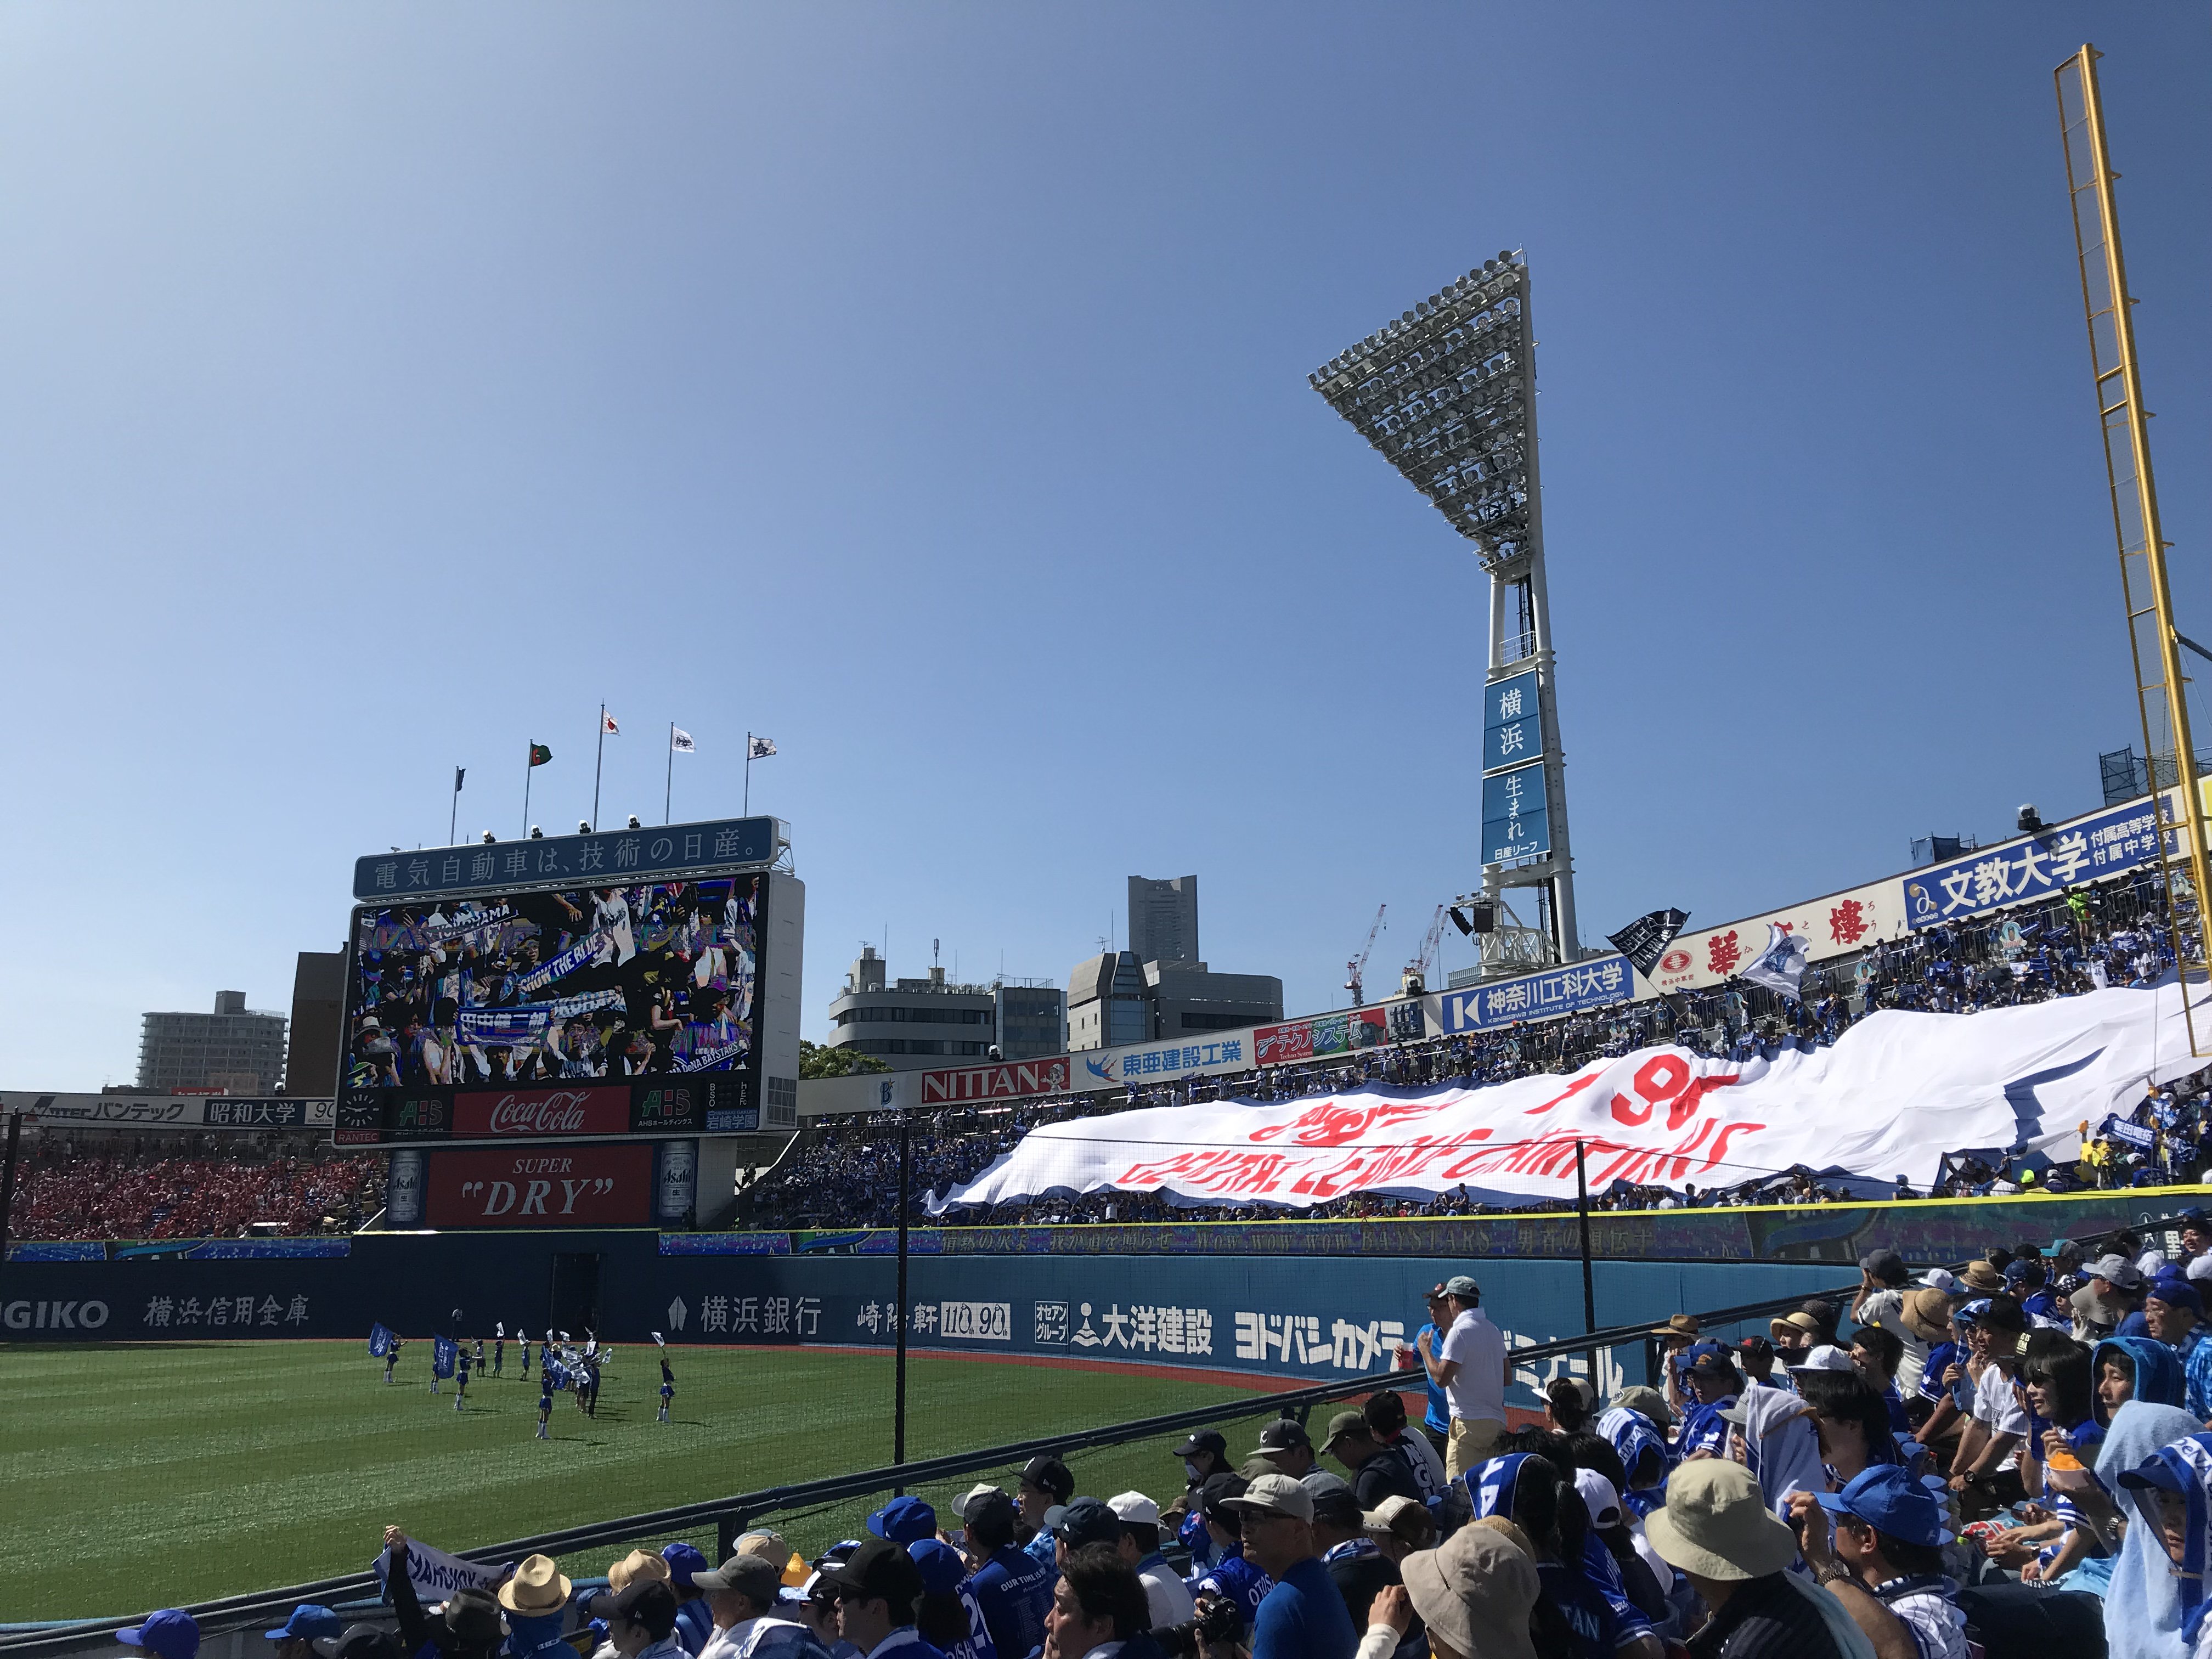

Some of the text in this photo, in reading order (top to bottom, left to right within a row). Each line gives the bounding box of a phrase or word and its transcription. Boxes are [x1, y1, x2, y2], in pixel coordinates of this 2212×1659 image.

[1499, 688, 1525, 841] 横浜 生まれ
[374, 828, 754, 890] 電気自動車は、技術の日産。
[1494, 841, 1538, 860] 日産リーフ
[1940, 831, 2090, 916] 文教大学
[521, 932, 600, 992] SHOW THE BLUE
[1487, 961, 1624, 1016] 神奈川工科大学
[1528, 1005, 1564, 1018] INSTITUTE
[1565, 1002, 1576, 1011] OF
[1577, 990, 1626, 1008] TECHNOLOGY
[1277, 1023, 1363, 1053] テクノシステム
[701, 1042, 738, 1065] BAYSTARS
[1122, 1039, 1242, 1078] 東亜建設工業
[1279, 1050, 1313, 1061] Techno System
[709, 1081, 747, 1091] B H
[925, 1064, 1041, 1100] NITTAN
[95, 1102, 184, 1120] バンテック
[210, 1102, 296, 1124] 昭和大学
[490, 1091, 592, 1133] Coca-Cola
[637, 1118, 693, 1128] AHSホールディングス
[706, 1114, 757, 1130] 岩崎学園
[338, 1133, 378, 1142] RANTEC
[512, 1158, 573, 1175] SUPER
[663, 1169, 692, 1184] Asahi
[393, 1176, 419, 1190] Asahi
[672, 1188, 681, 1197] 生
[1361, 1224, 1492, 1253] BAYSTARS
[0, 1299, 109, 1330] GIKO
[142, 1293, 310, 1328] 横浜信用金庫
[700, 1295, 822, 1335] 横浜銀行
[1036, 1303, 1067, 1323] オセアン
[1036, 1322, 1067, 1342] グループ
[1101, 1303, 1213, 1356] 大洋建設
[1235, 1311, 1404, 1373] ヨドバシカメラ
[1502, 1329, 1624, 1398] ミナール
[1619, 1425, 1645, 1464] HAMA
[1000, 1578, 1022, 1593] OUR
[1019, 1573, 1036, 1585] TIME
[1248, 1573, 1276, 1606] OTOS
